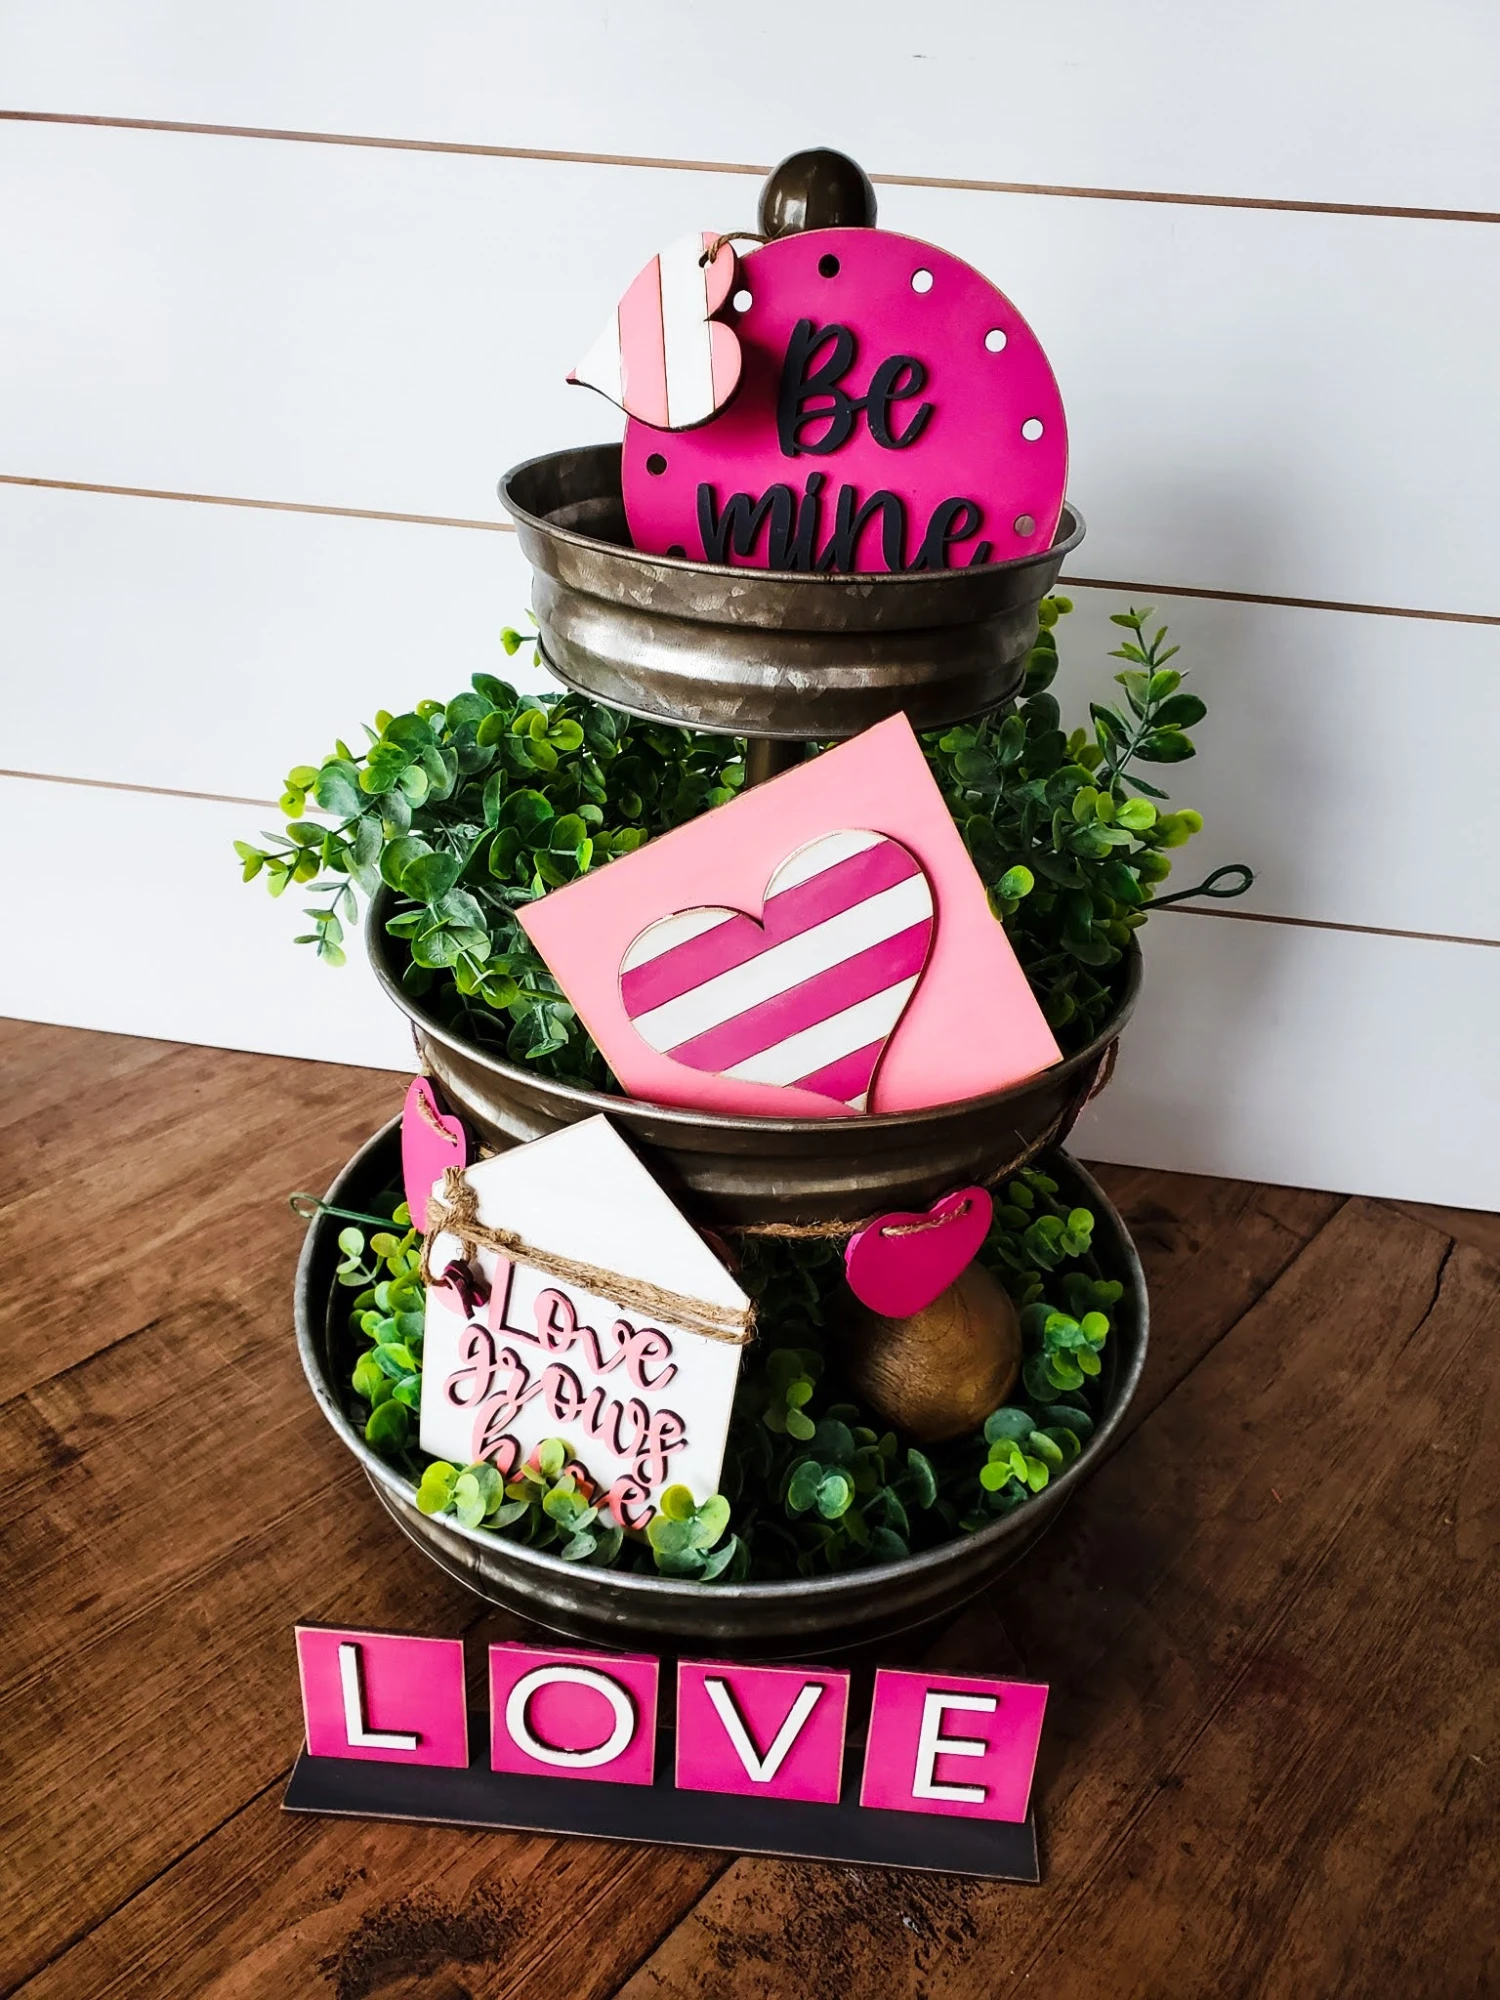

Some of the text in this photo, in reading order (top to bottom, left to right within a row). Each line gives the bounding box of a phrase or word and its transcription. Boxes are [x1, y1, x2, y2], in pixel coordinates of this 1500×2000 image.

[776, 318, 934, 458] Be
[696, 471, 993, 574] mine
[488, 1255, 679, 1392] Love
[443, 1323, 689, 1488] grows
[337, 1641, 998, 1804] LOVE
